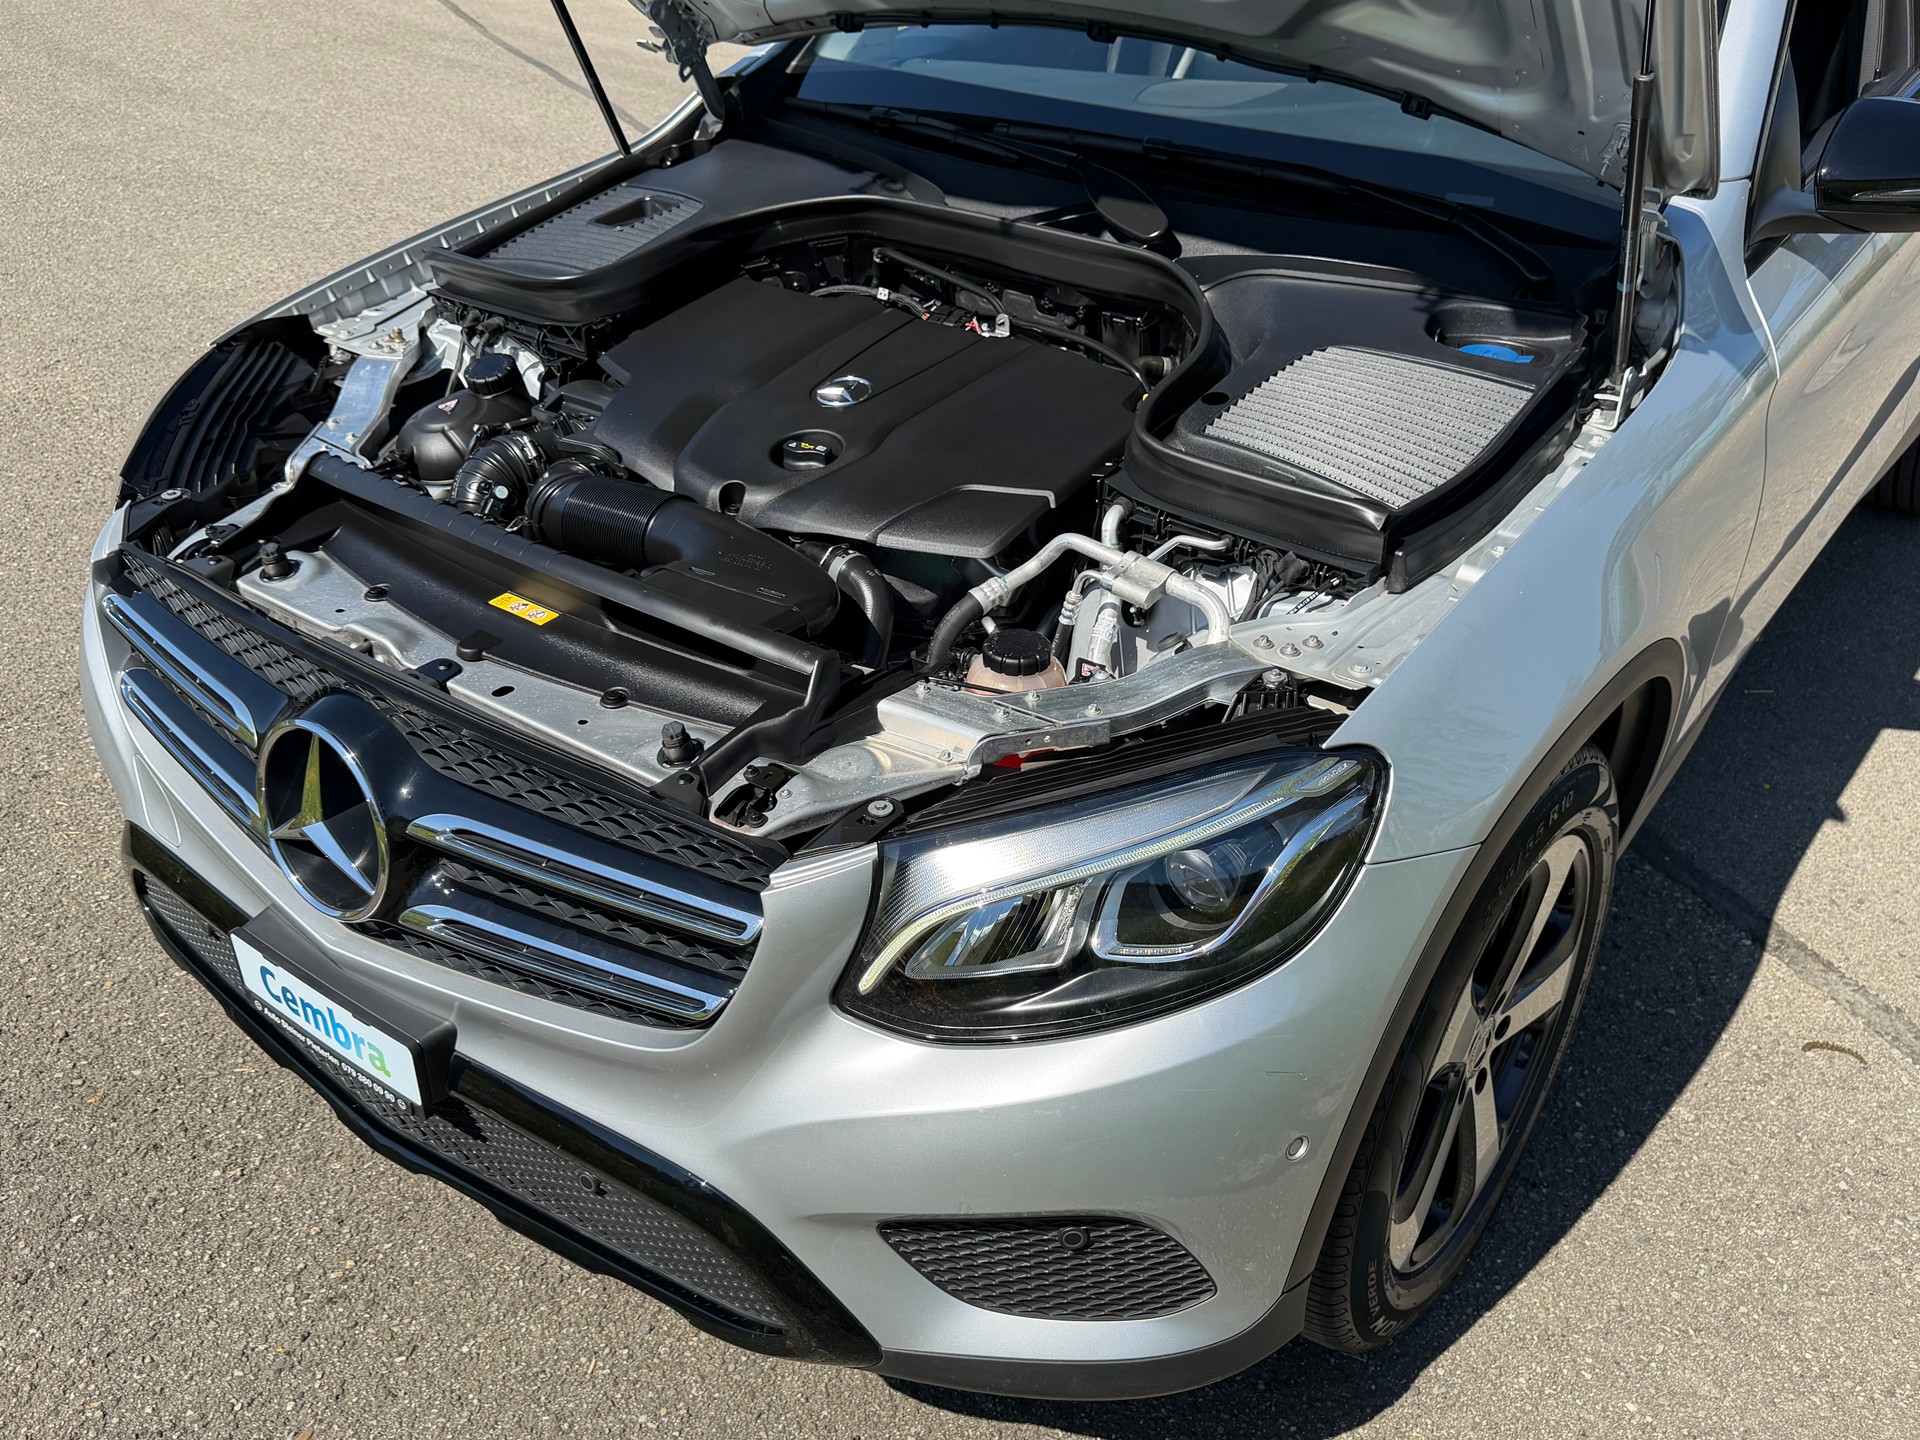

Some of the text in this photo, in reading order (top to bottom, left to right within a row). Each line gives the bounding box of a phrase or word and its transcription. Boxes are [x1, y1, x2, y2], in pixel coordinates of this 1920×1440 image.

[259, 965, 392, 1078] Cembra
[264, 1007, 281, 1024] Auto
[1368, 1258, 1380, 1317] VERDE
